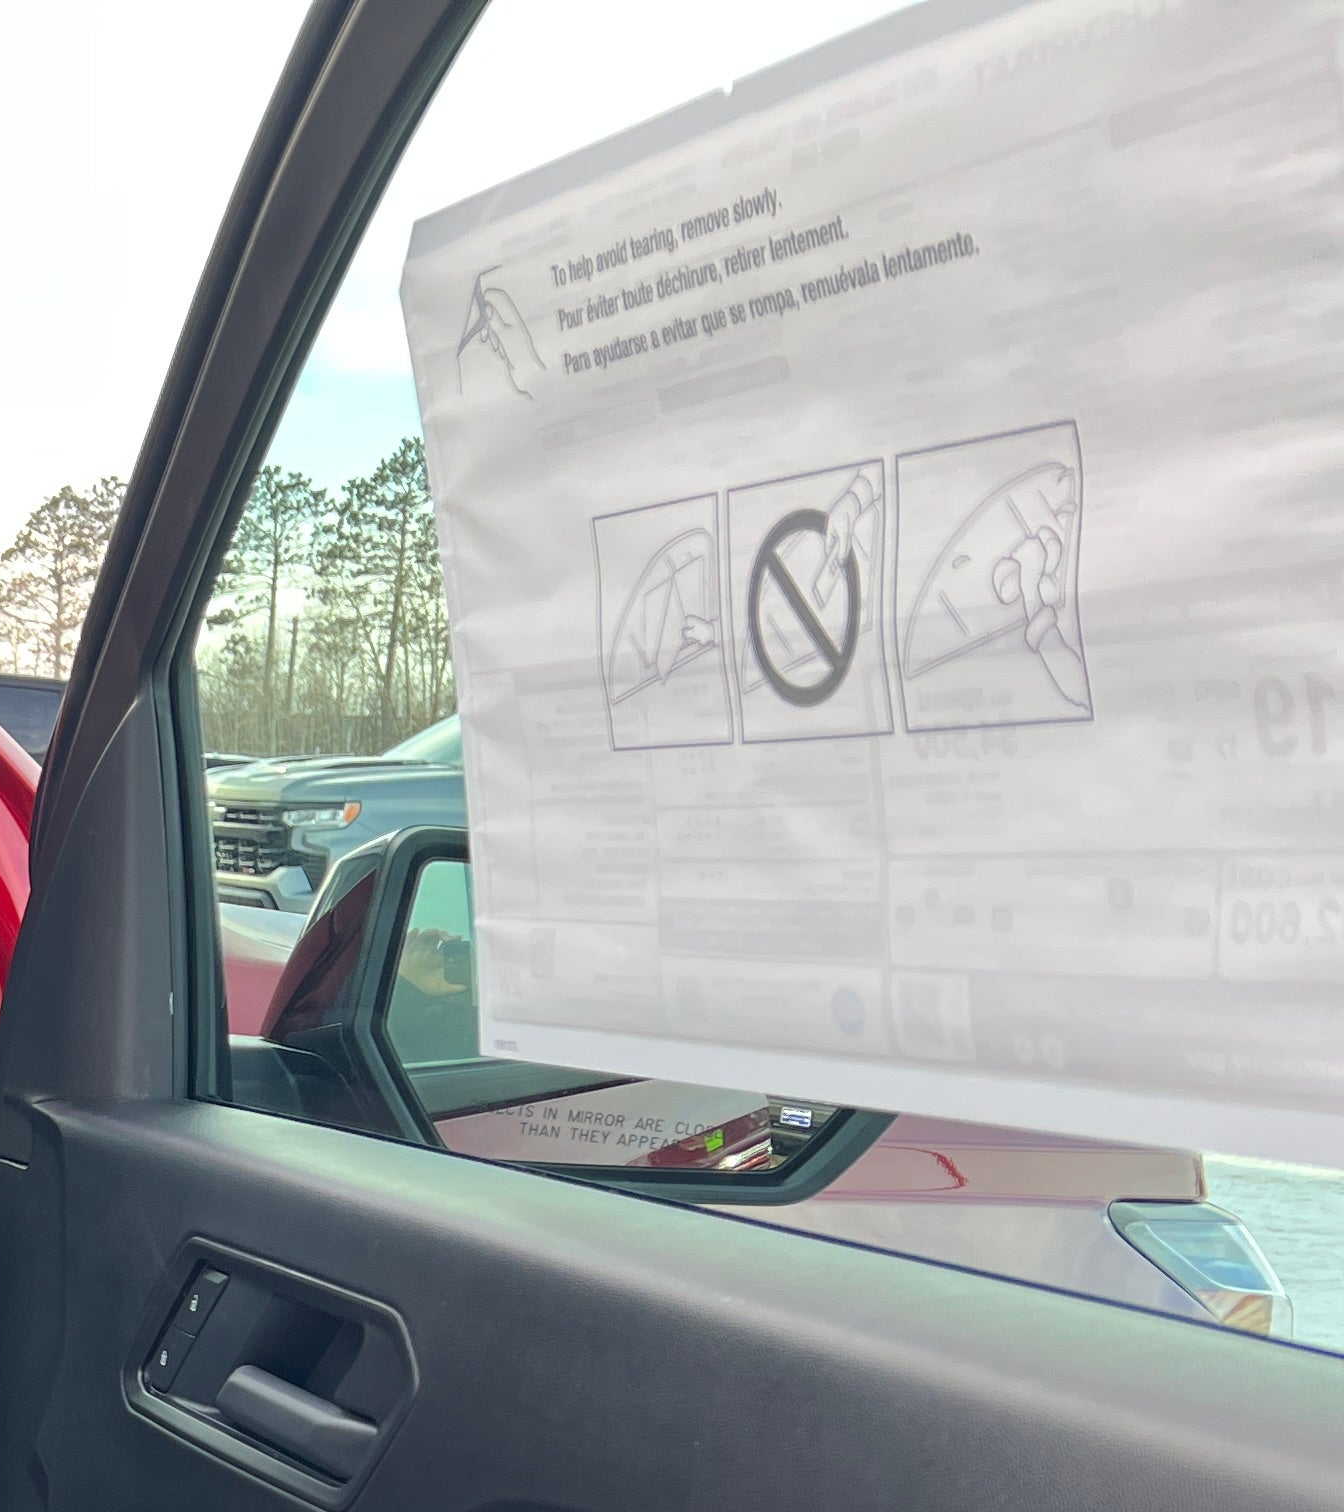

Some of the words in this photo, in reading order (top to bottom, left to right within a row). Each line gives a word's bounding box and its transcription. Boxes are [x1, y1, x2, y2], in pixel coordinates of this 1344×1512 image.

[551, 264, 566, 287] To
[568, 255, 593, 281] help
[596, 240, 628, 272] avoid
[630, 227, 678, 259] tearing,
[681, 207, 730, 243] remove
[733, 186, 782, 224] slowly.
[558, 308, 583, 331] Pour
[587, 294, 620, 323] éviter
[621, 281, 654, 311] toute
[656, 261, 723, 300] déchirure,
[724, 245, 767, 279] retirer
[769, 214, 849, 262] lentement.
[564, 352, 591, 375] Para
[593, 332, 648, 370] ayudarse
[651, 329, 661, 349] a
[662, 317, 698, 346] evitar
[701, 309, 728, 336] que
[729, 304, 747, 325] se
[749, 287, 801, 320] rompa,
[800, 264, 880, 304] remuévala
[882, 231, 980, 280] lentamente.
[520, 1121, 560, 1139] THAN
[570, 1127, 611, 1144] THEY
[543, 1107, 558, 1120] IN
[568, 1109, 625, 1128] MIRROR
[635, 1117, 663, 1133] ARE
